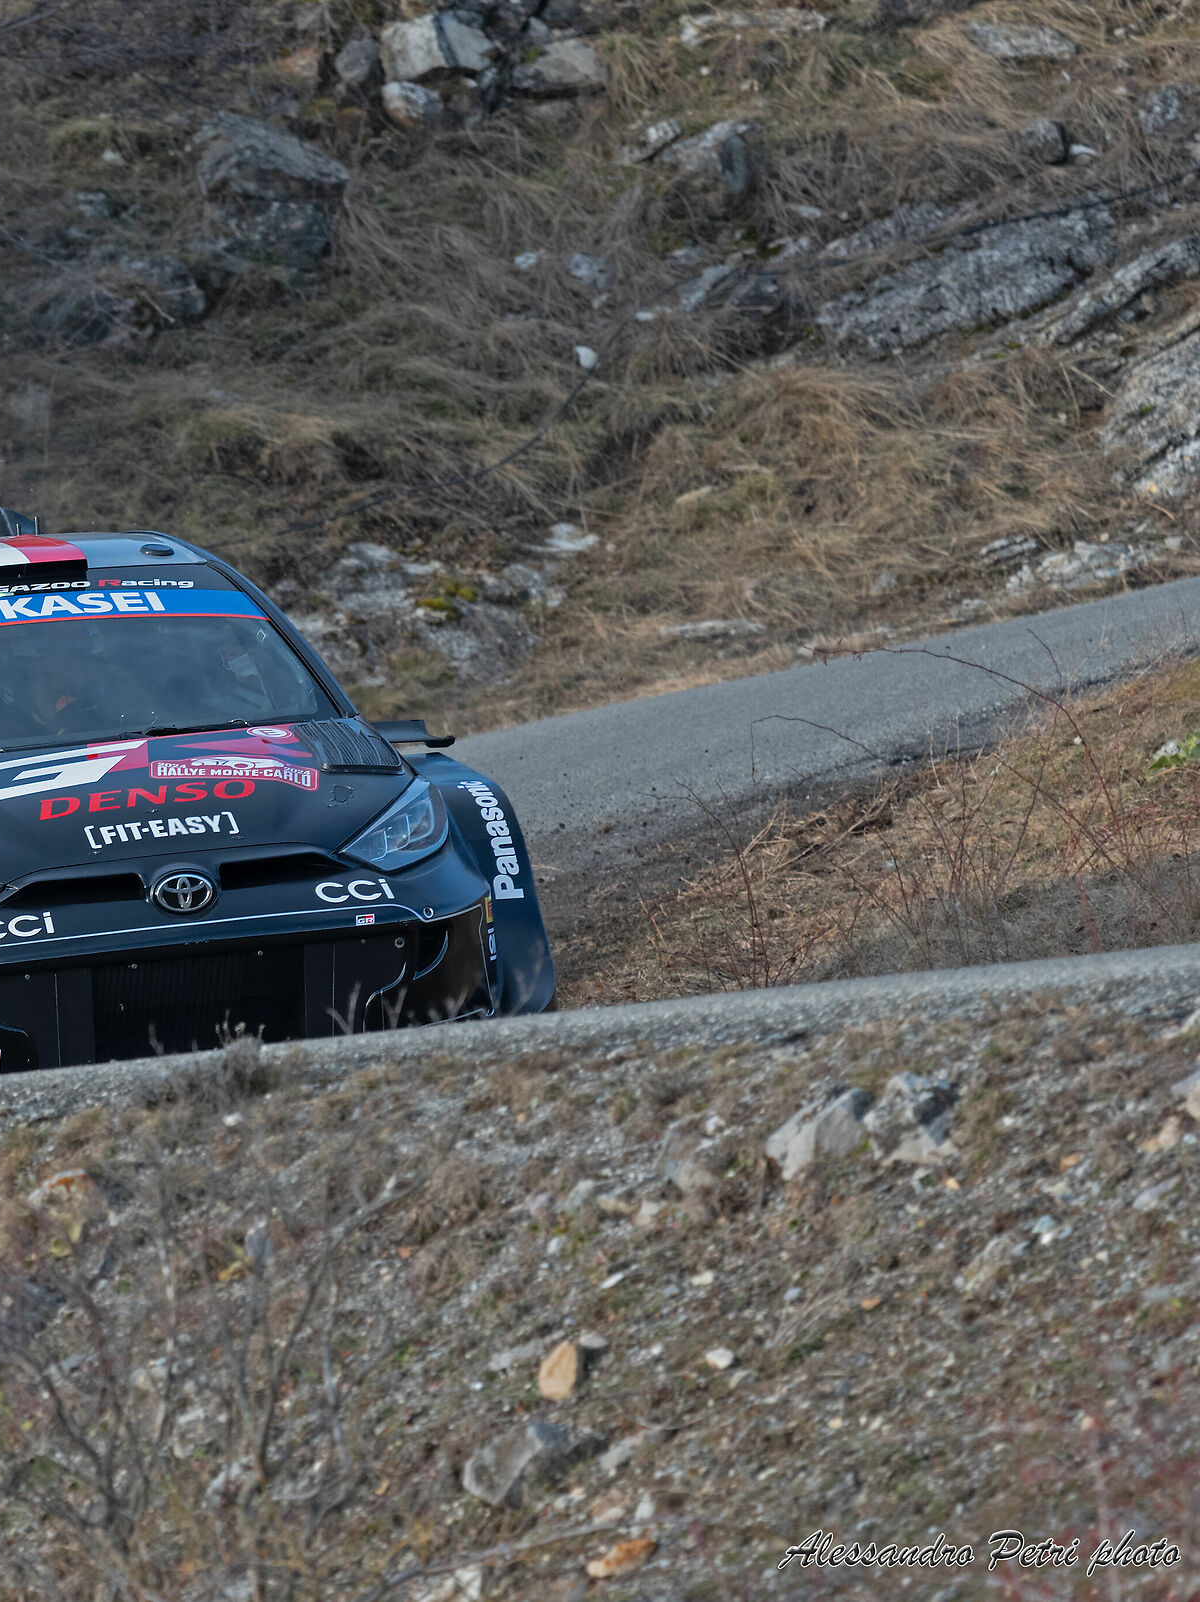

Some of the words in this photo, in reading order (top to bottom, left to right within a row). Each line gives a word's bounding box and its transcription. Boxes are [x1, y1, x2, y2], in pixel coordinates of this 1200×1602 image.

[99, 578, 194, 589] Racing
[157, 766, 206, 777] RALLYE
[210, 768, 312, 787] MONTE-CARLO
[39, 779, 256, 821] DENSO
[457, 780, 525, 901] Panasonic
